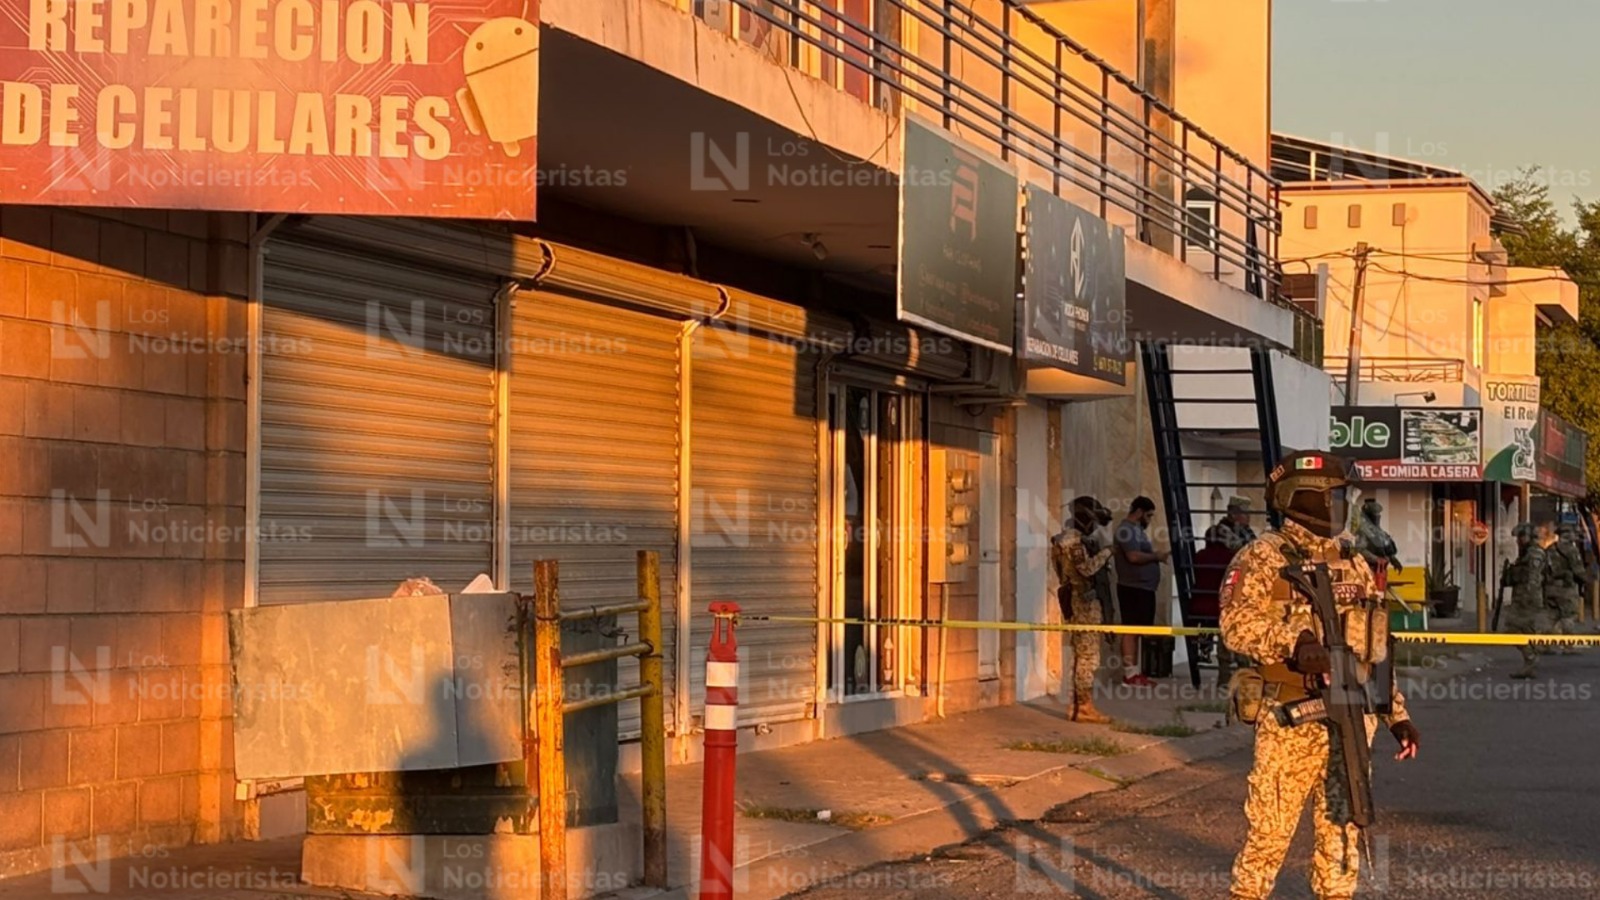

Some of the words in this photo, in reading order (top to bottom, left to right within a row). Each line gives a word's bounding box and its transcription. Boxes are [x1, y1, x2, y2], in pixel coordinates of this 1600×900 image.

[29, 0, 430, 65] REPARECION
[1, 81, 80, 147] DE
[96, 84, 452, 161] CELULARES
[1381, 465, 1429, 478] COMIDA
[1431, 465, 1479, 478] CASERA
